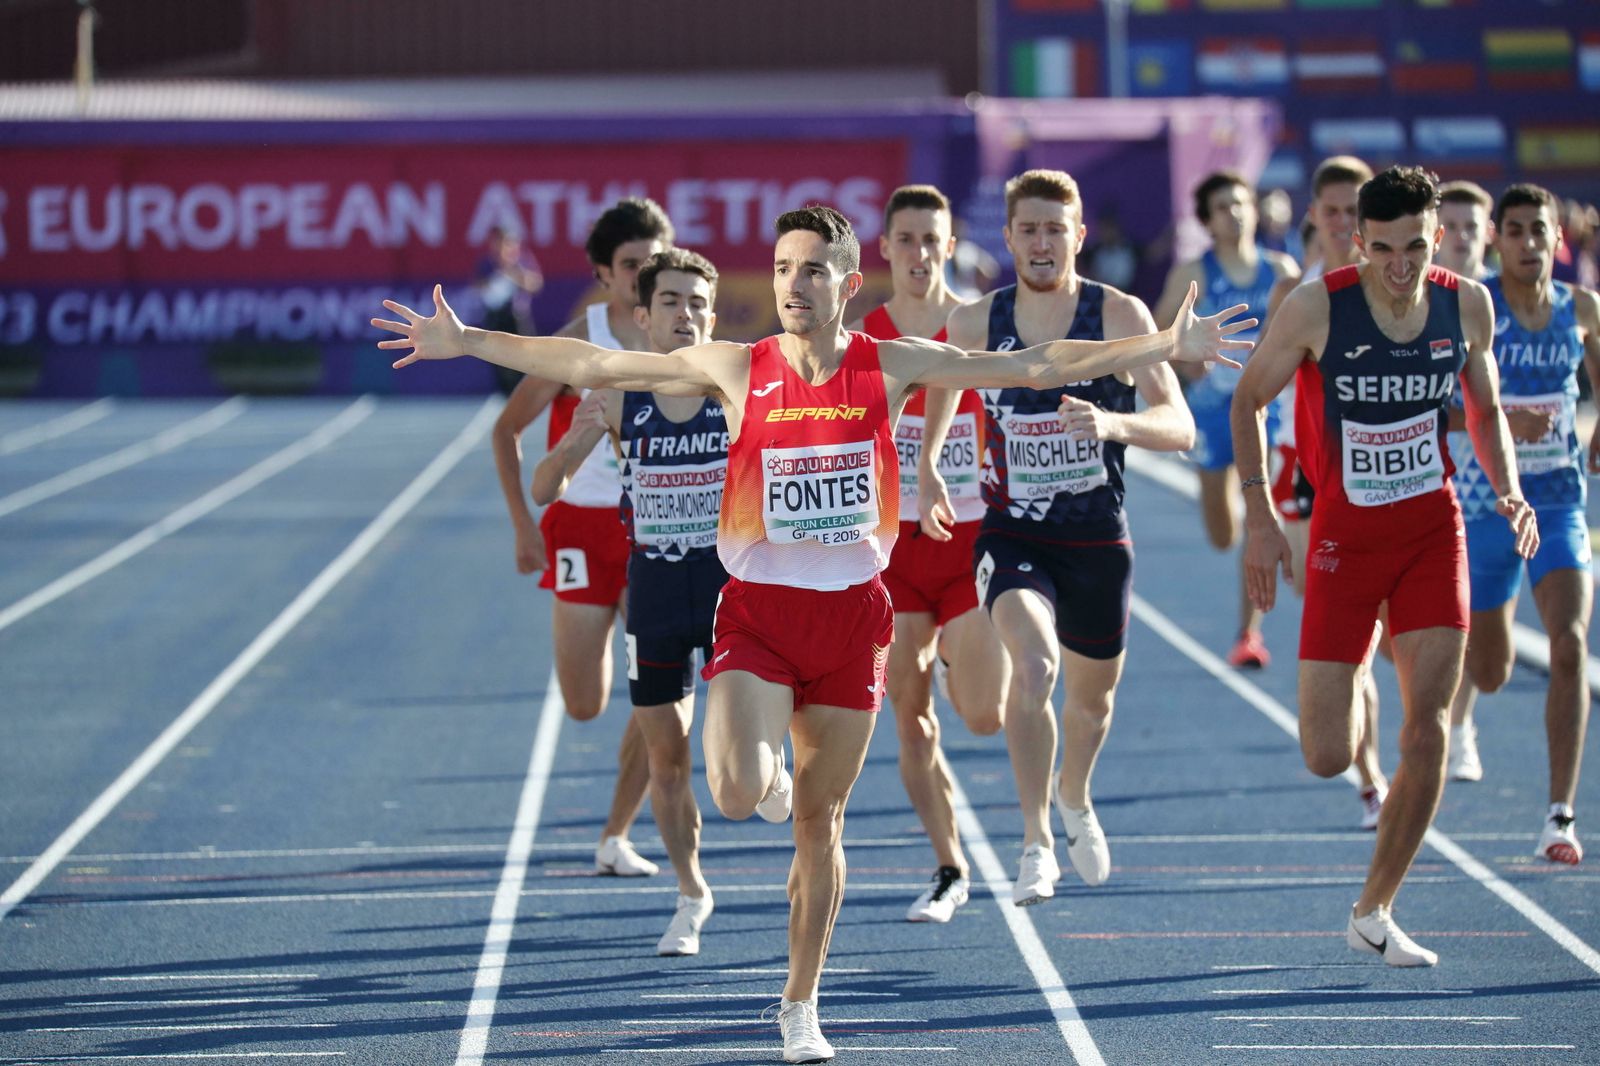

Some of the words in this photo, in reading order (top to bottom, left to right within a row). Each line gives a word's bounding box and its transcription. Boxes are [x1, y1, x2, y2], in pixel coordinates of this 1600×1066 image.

[28, 183, 446, 252] EUROPEAN
[467, 179, 882, 247] ATHETICS
[1499, 342, 1569, 368] ITALIA
[1335, 373, 1454, 403] SERBIA
[765, 404, 868, 423] ESPAÑA
[1021, 420, 1064, 435] BAUH
[1360, 418, 1434, 445] BAUHAUS
[648, 432, 729, 458] FRANCE
[1010, 439, 1099, 468] MISCHLER
[1351, 439, 1433, 475] BIBIC
[784, 451, 870, 475] BAUHAUS
[1031, 473, 1051, 482] RUN
[1053, 469, 1084, 480] CLEAN
[649, 467, 726, 488] BAUHAUS
[1065, 480, 1089, 492] 2019
[636, 489, 723, 520] JOCTEUR-MONROZI
[769, 473, 870, 512] FONTES
[660, 524, 680, 533] RUN
[682, 520, 714, 532] CLEAN
[820, 514, 855, 527] CLEAN
[833, 529, 860, 543] 2019
[561, 557, 577, 584] 2
